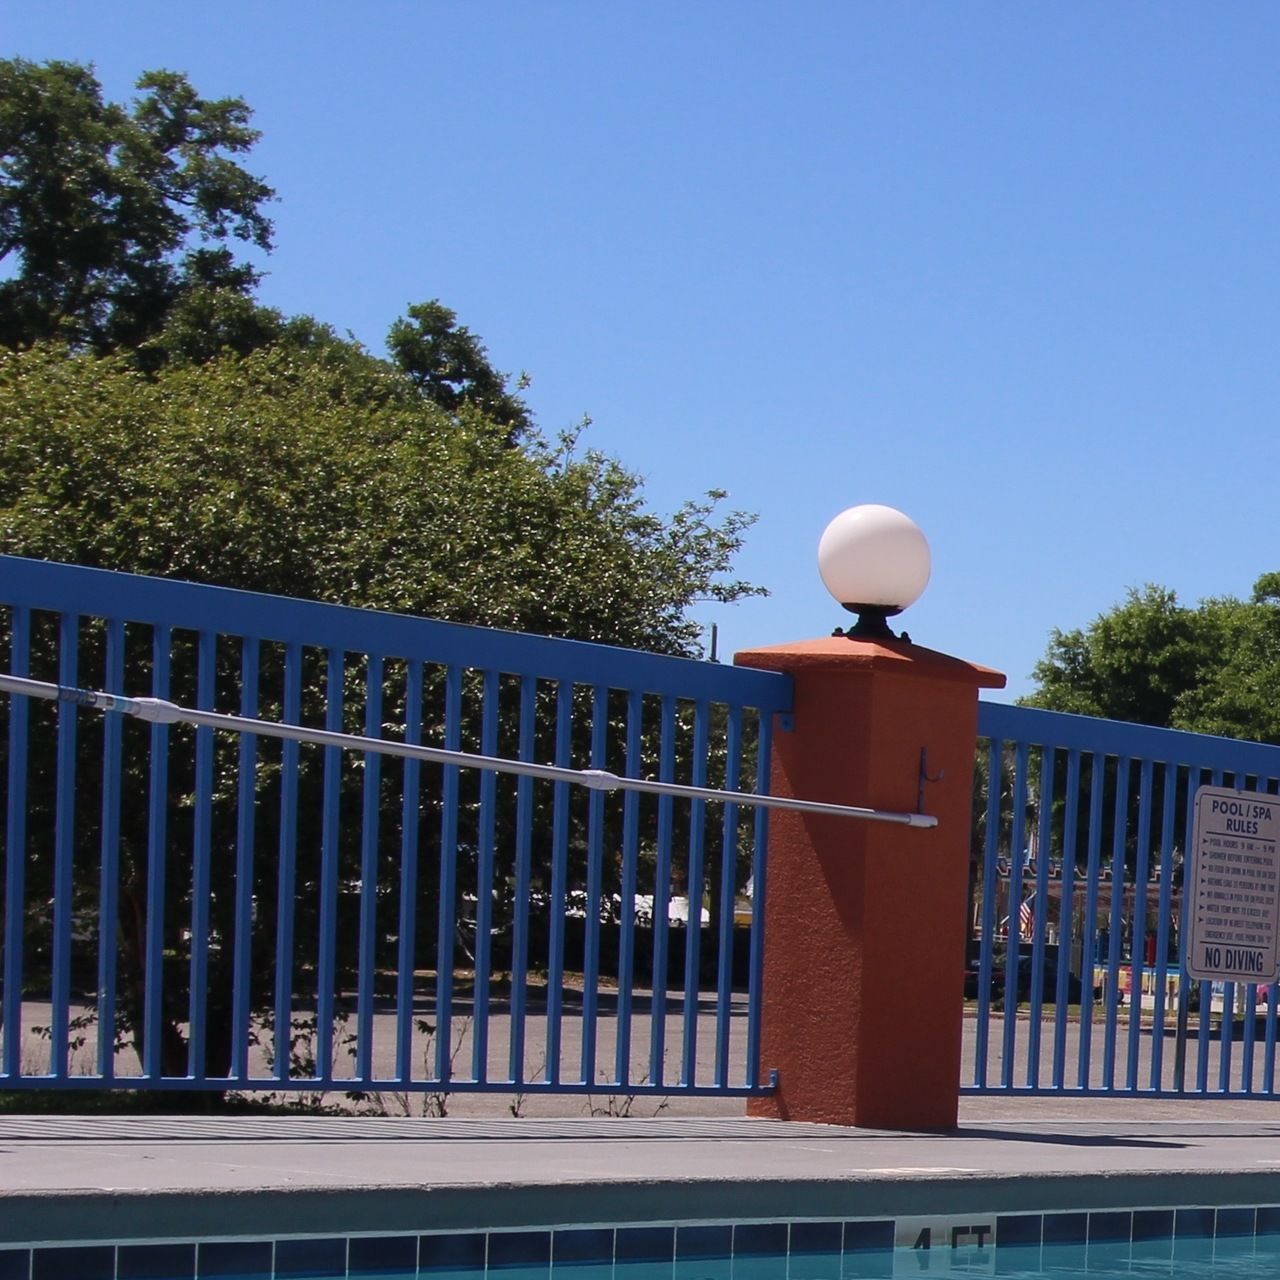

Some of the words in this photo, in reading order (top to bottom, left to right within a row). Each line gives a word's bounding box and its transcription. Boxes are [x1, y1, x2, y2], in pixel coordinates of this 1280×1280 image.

[1212, 800, 1243, 817] POOL
[1252, 805, 1272, 821] SPA
[1226, 818, 1258, 835] RULES
[1205, 947, 1220, 969] NO
[1225, 949, 1263, 973] DIVING
